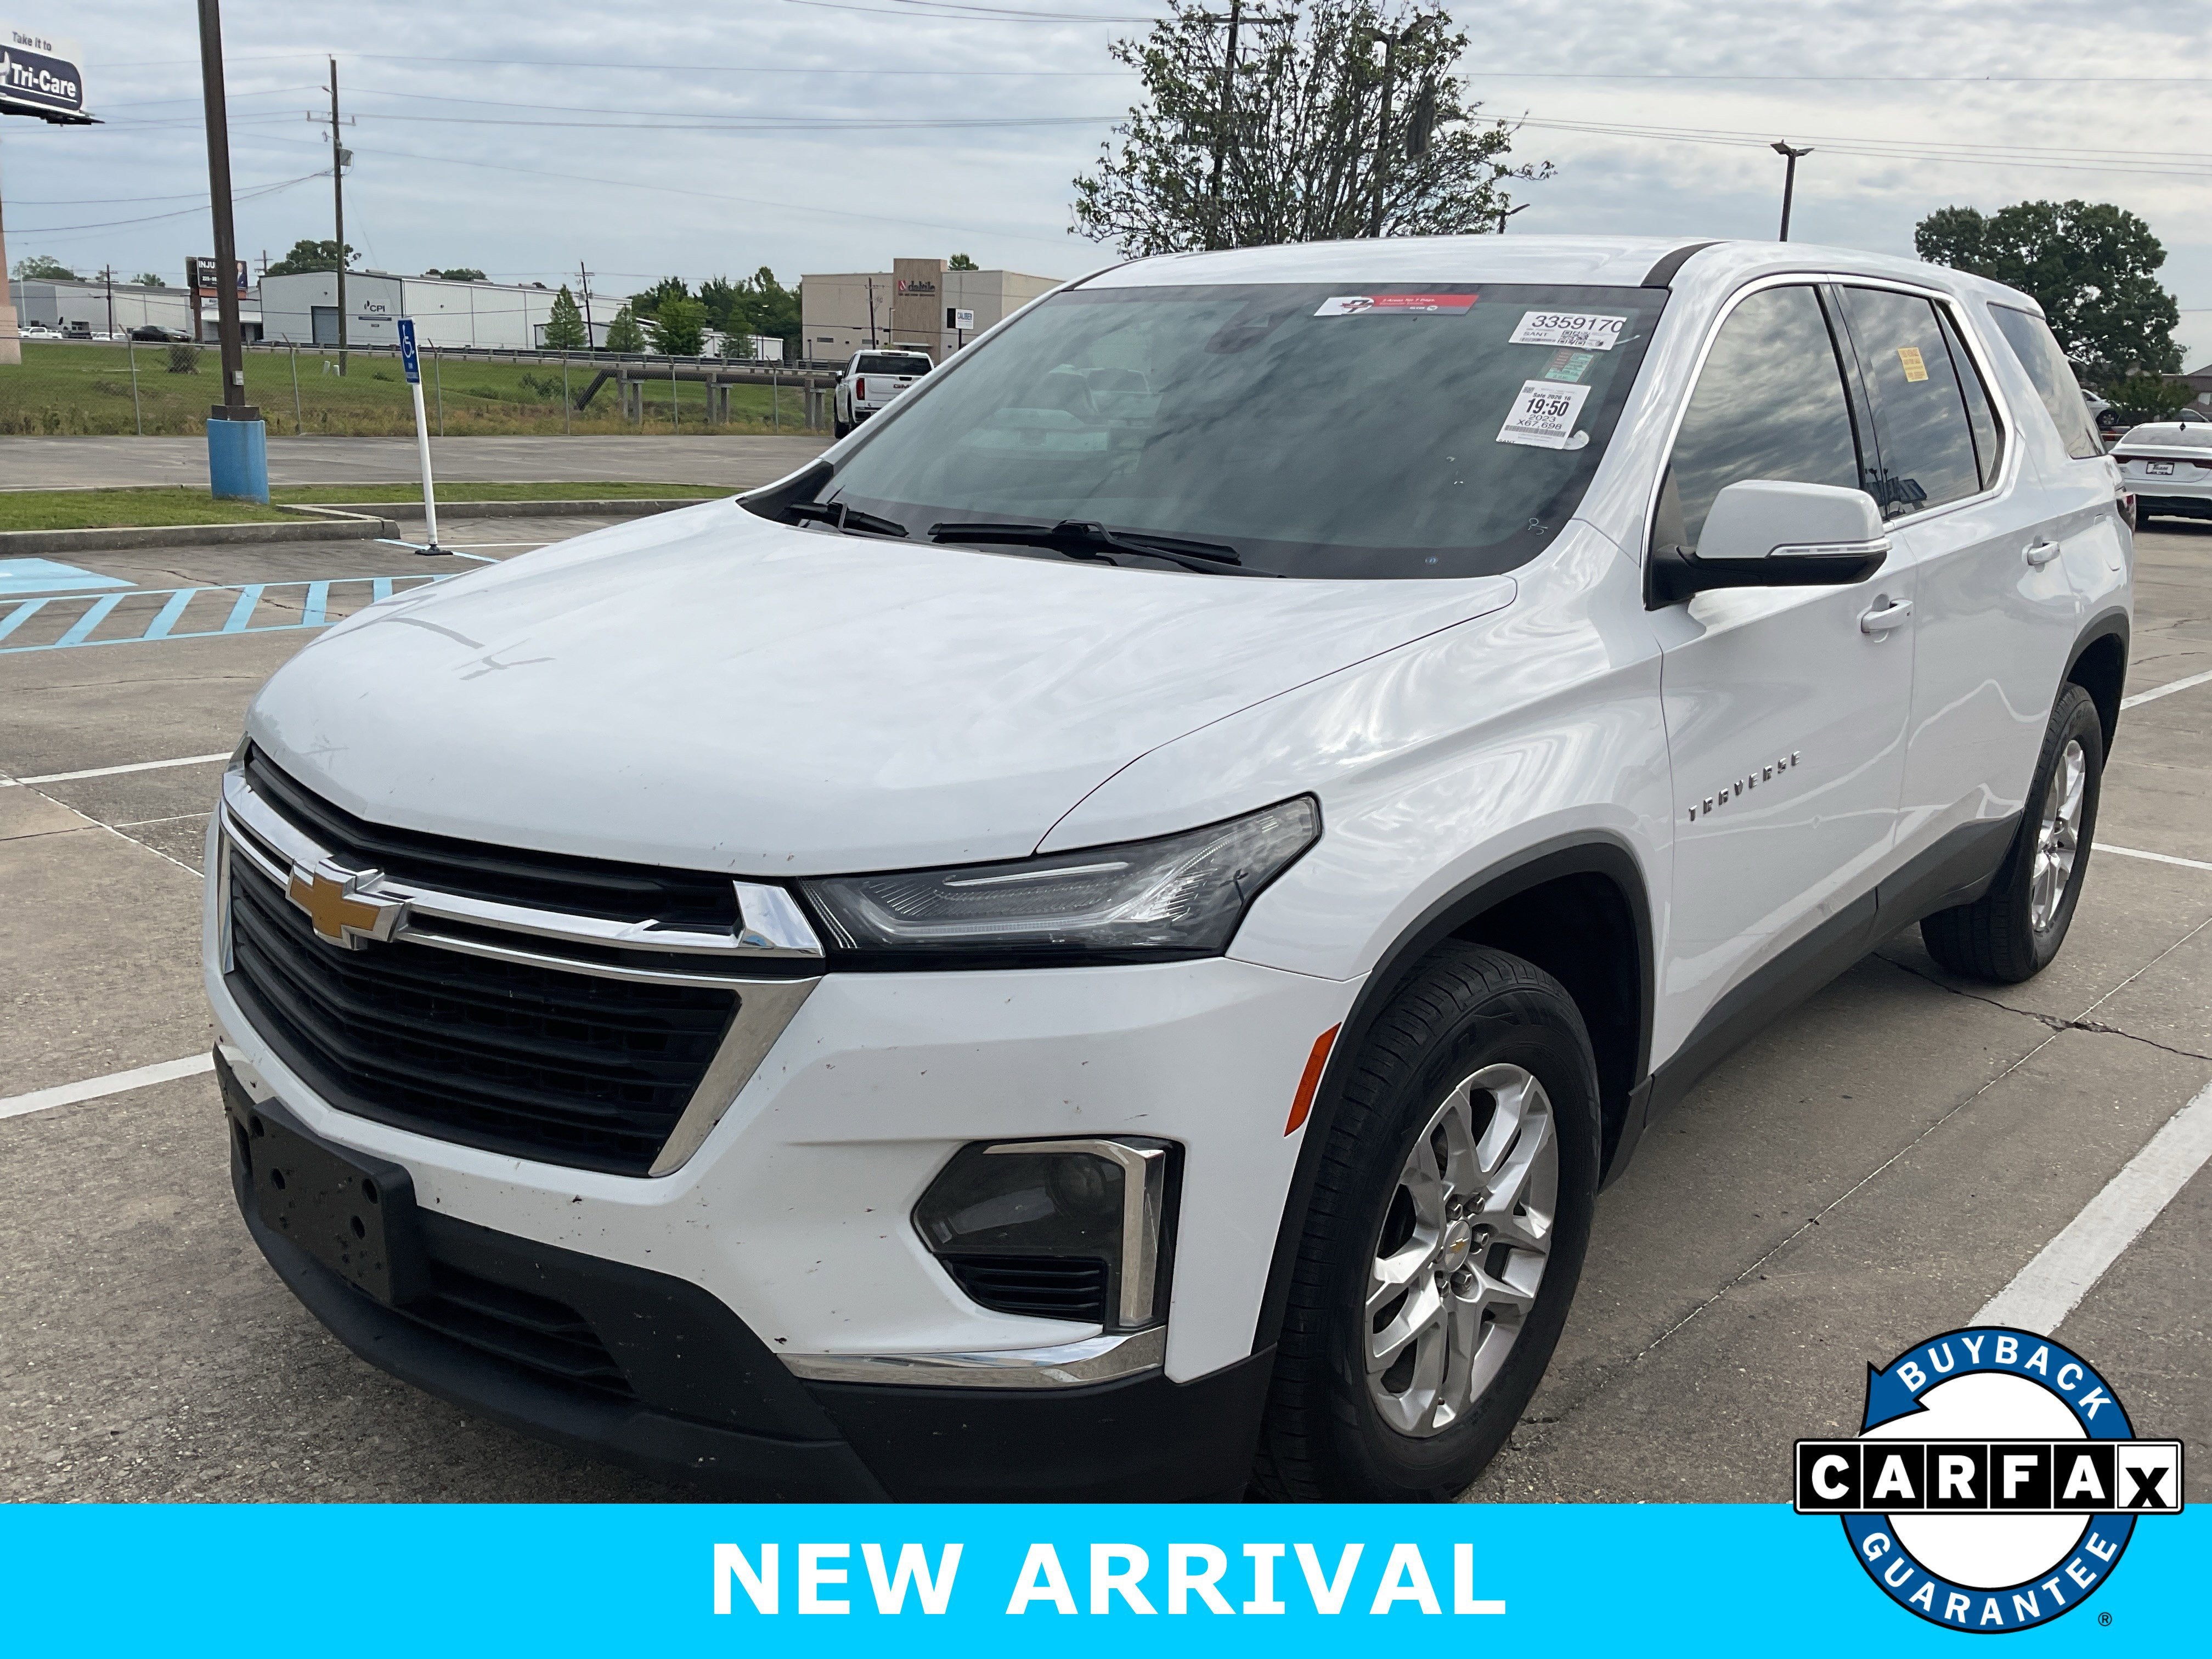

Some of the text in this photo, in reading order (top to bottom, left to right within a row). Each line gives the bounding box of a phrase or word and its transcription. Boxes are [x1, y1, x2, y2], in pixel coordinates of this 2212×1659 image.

[12, 31, 32, 46] Take
[43, 41, 52, 51] to
[11, 63, 76, 97] Tri-Care
[198, 260, 215, 269] INJU
[957, 312, 973, 320] CALIBER
[1532, 315, 1625, 333] 3359170
[1526, 398, 1570, 417] 19:50
[1528, 414, 1556, 422] 2023
[1689, 751, 1801, 822] TRAVERSE
